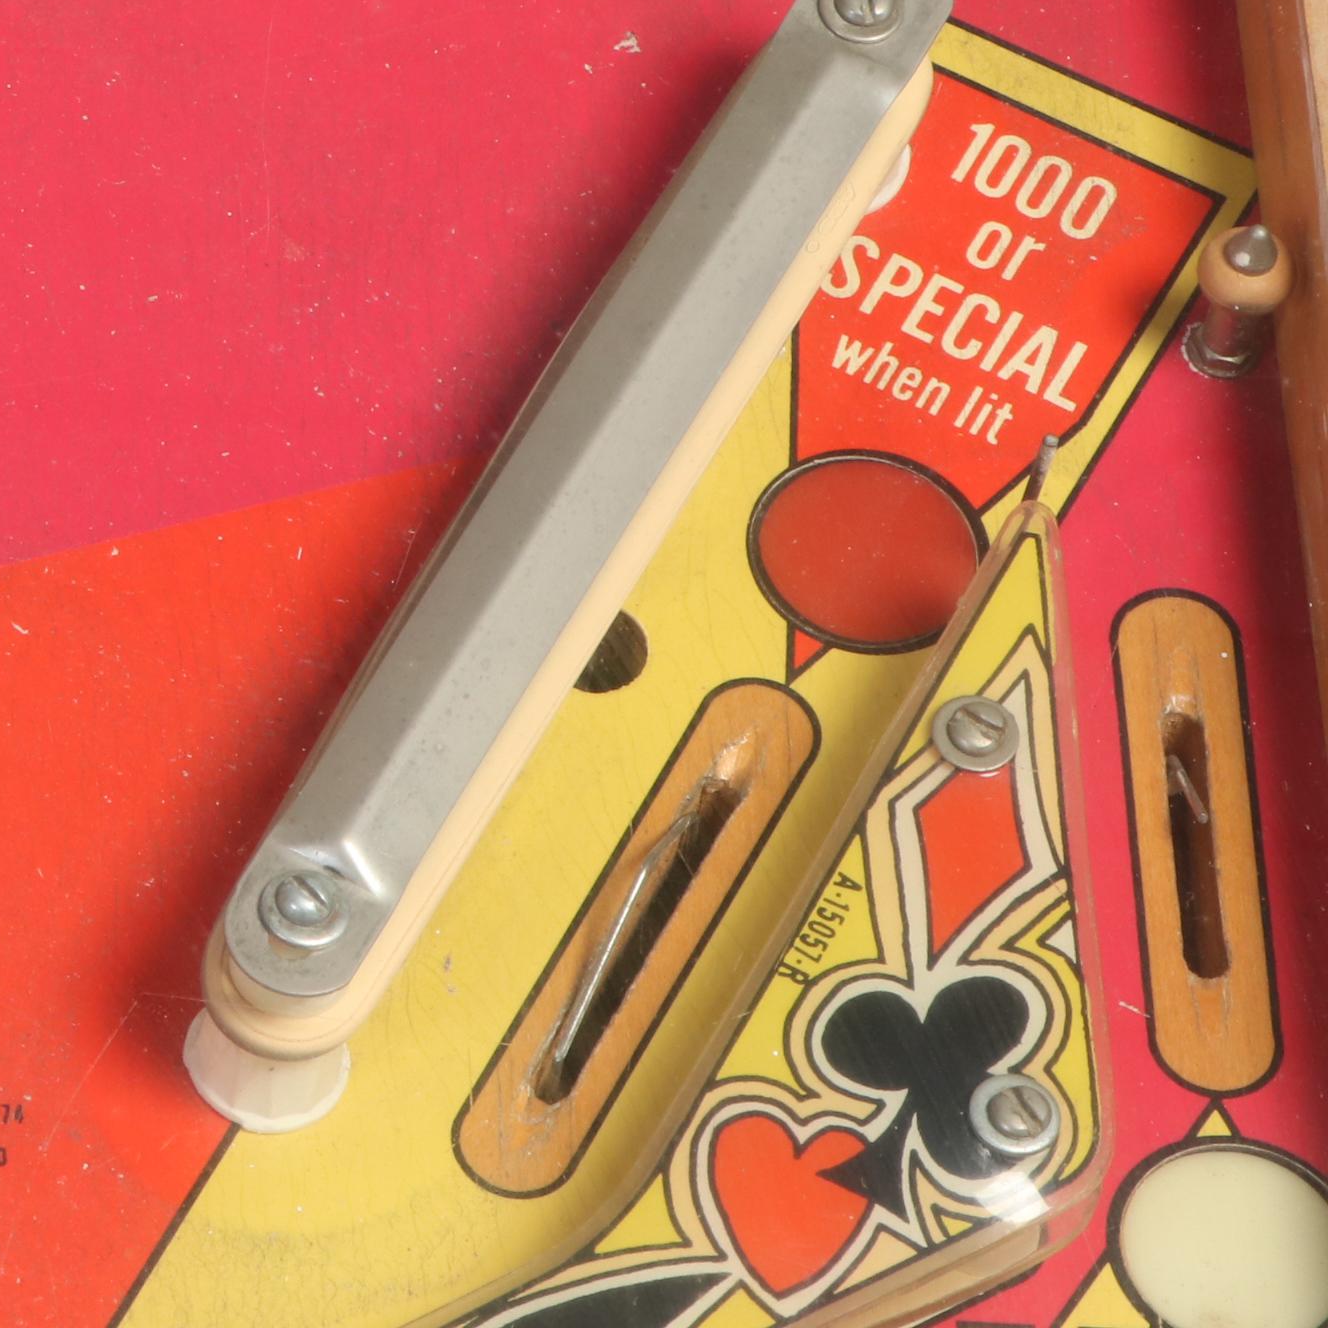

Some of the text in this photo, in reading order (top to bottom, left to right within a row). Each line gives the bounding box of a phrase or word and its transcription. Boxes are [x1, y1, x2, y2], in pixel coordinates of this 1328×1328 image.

[950, 122, 1118, 240] 1000
[965, 220, 1046, 281] or
[820, 234, 1089, 413] SPECIAL
[831, 334, 1015, 446] when lit
